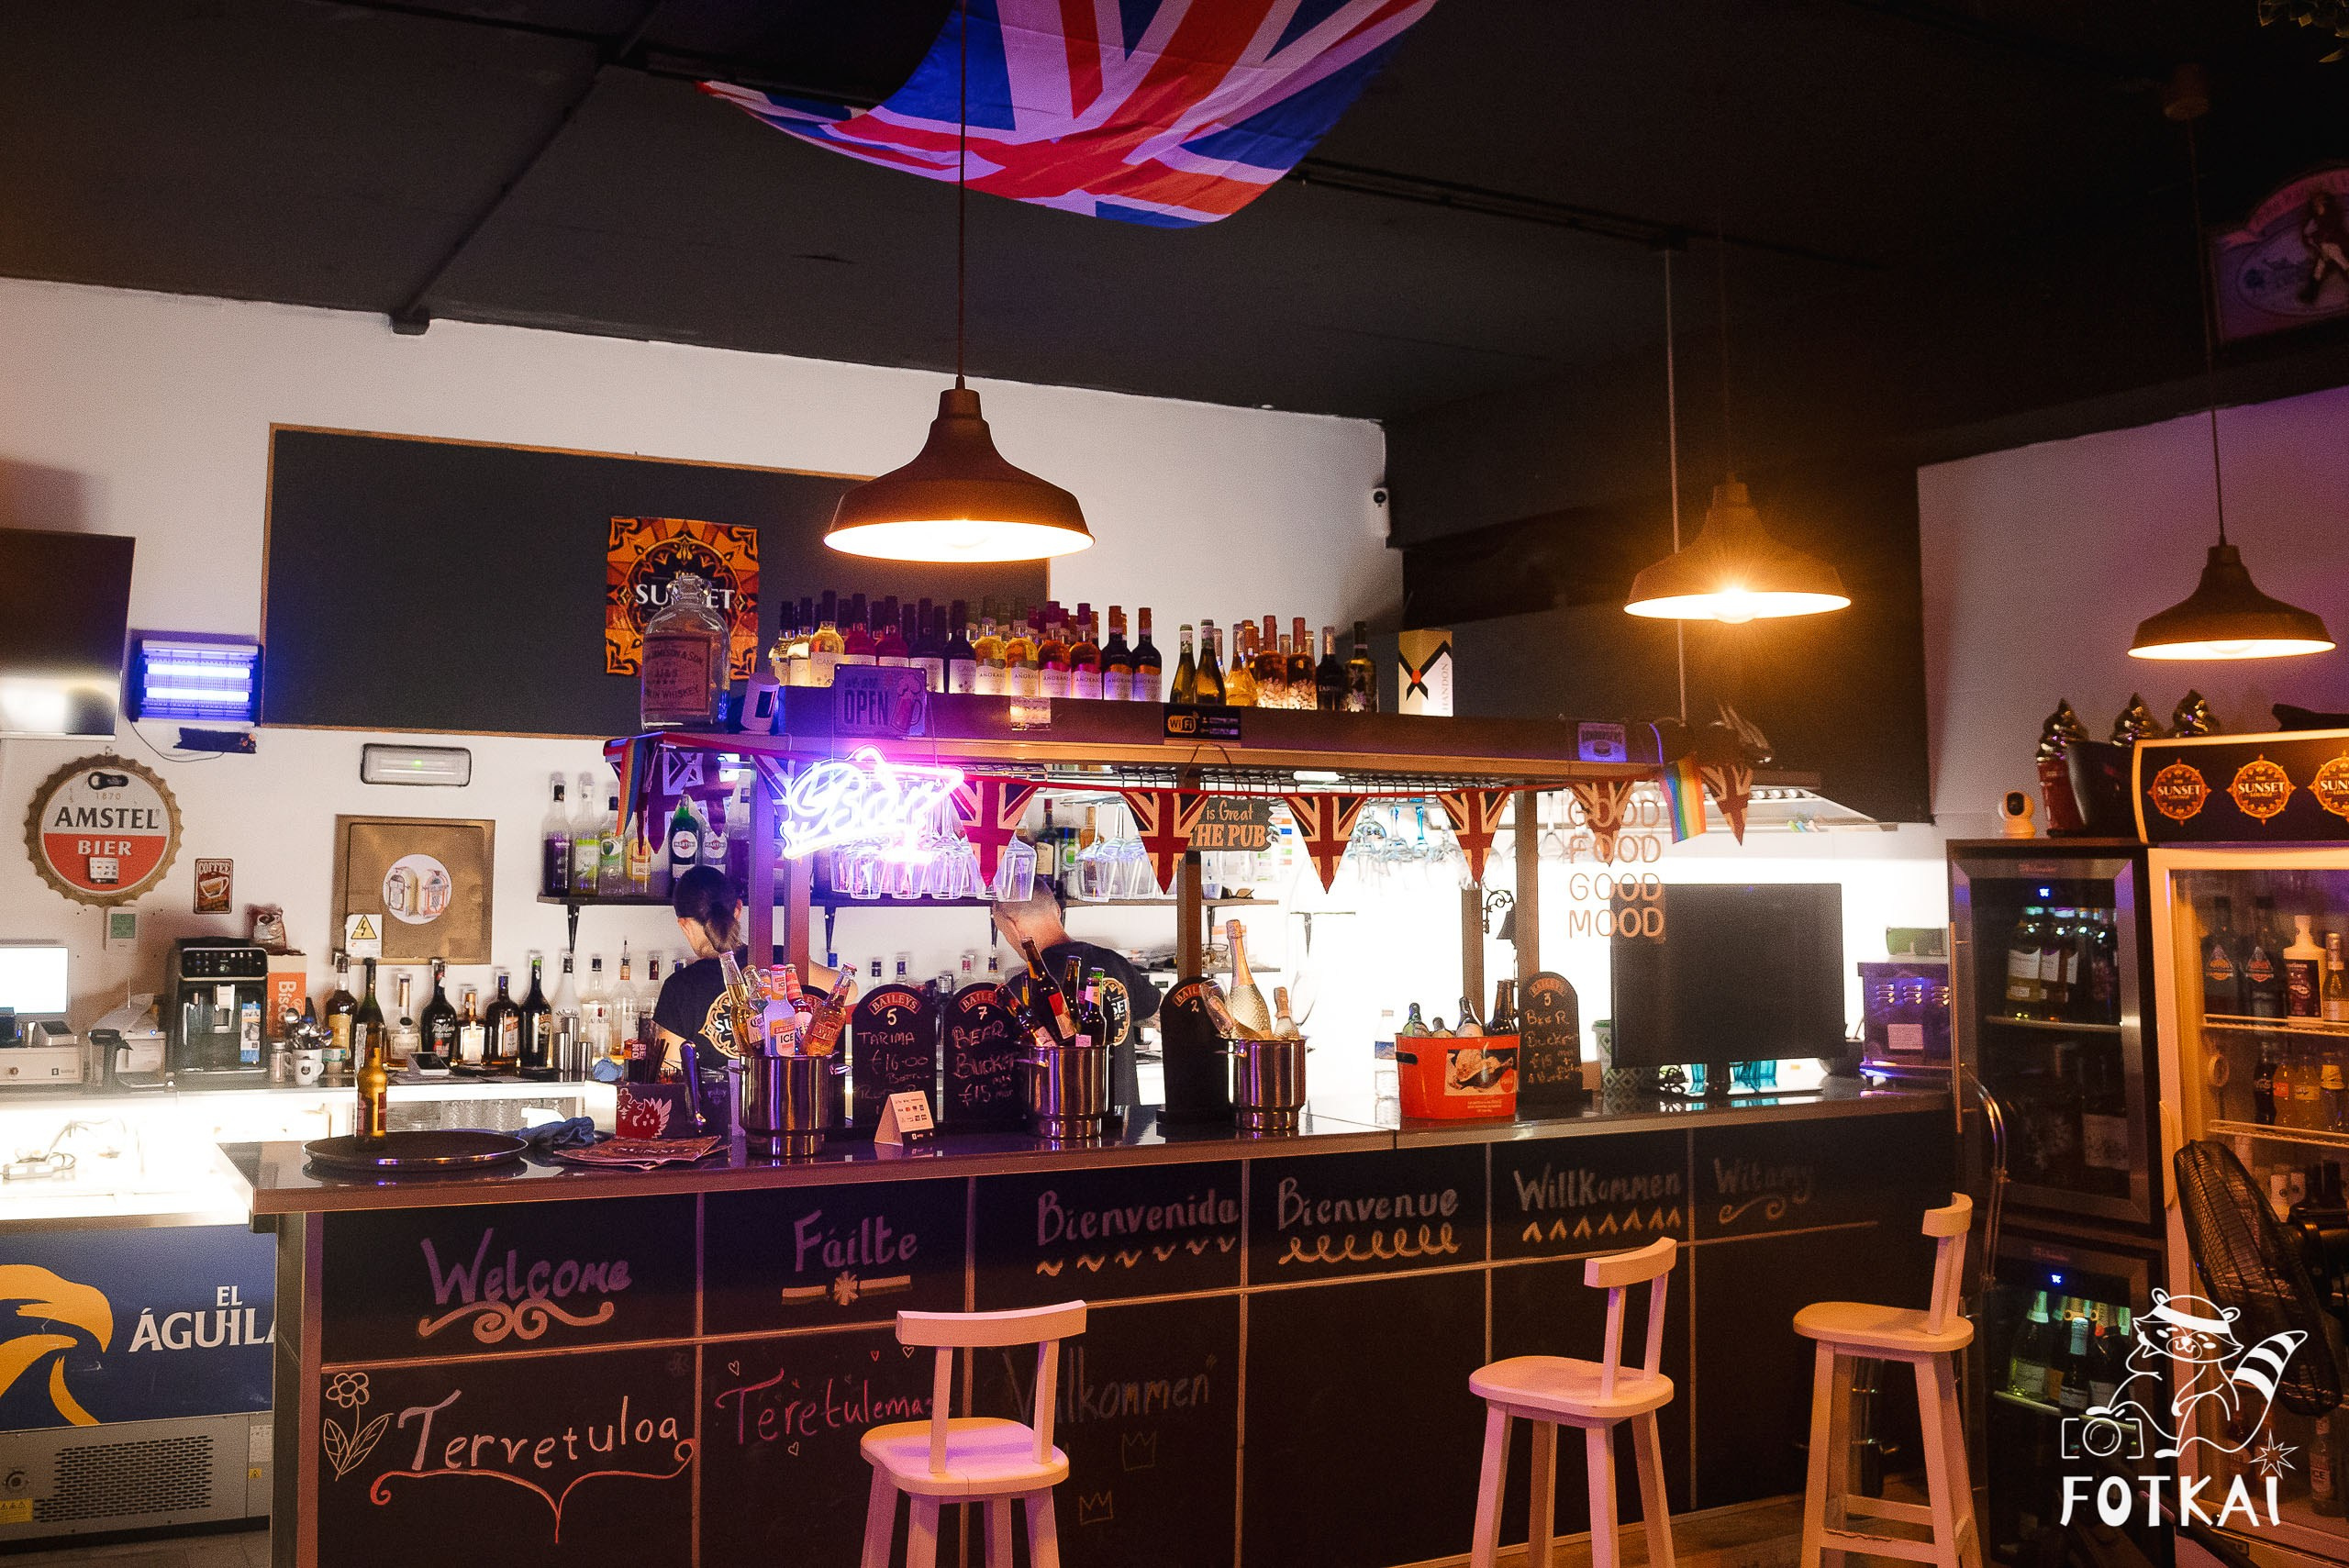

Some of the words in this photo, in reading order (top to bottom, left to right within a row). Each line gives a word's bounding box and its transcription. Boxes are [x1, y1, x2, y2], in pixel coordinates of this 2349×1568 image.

[635, 584, 736, 609] SUET
[1441, 662, 1450, 711] HANDON
[843, 689, 889, 727] OPEN
[95, 793, 121, 801] 1870
[2156, 784, 2201, 796] SUNSET
[2237, 780, 2284, 795] SUNSET
[54, 806, 160, 829] AMSTEL
[1206, 806, 1216, 821] is
[1219, 799, 1253, 822] Great
[1568, 798, 1661, 828] GOOD
[1227, 823, 1266, 848] PUB
[77, 839, 132, 857] BIER
[1568, 834, 1662, 864] FOOD
[198, 862, 231, 875] COFFEE
[1568, 872, 1664, 903] GOOD
[1568, 907, 1665, 940] MOOD
[872, 994, 918, 1012] BAILEYS
[962, 991, 998, 1010] BAILE
[1190, 998, 1200, 1013] 2
[1543, 992, 1552, 1006] 3
[886, 1007, 898, 1026] 5
[977, 1006, 988, 1021] 7
[779, 1032, 795, 1044] ICE
[1277, 1176, 1459, 1231] Bienvenue
[1037, 1189, 1241, 1247] Bienvenida
[419, 1227, 633, 1305] Welcome
[217, 1284, 243, 1307] EL
[397, 1388, 679, 1472] Tervetuloa
